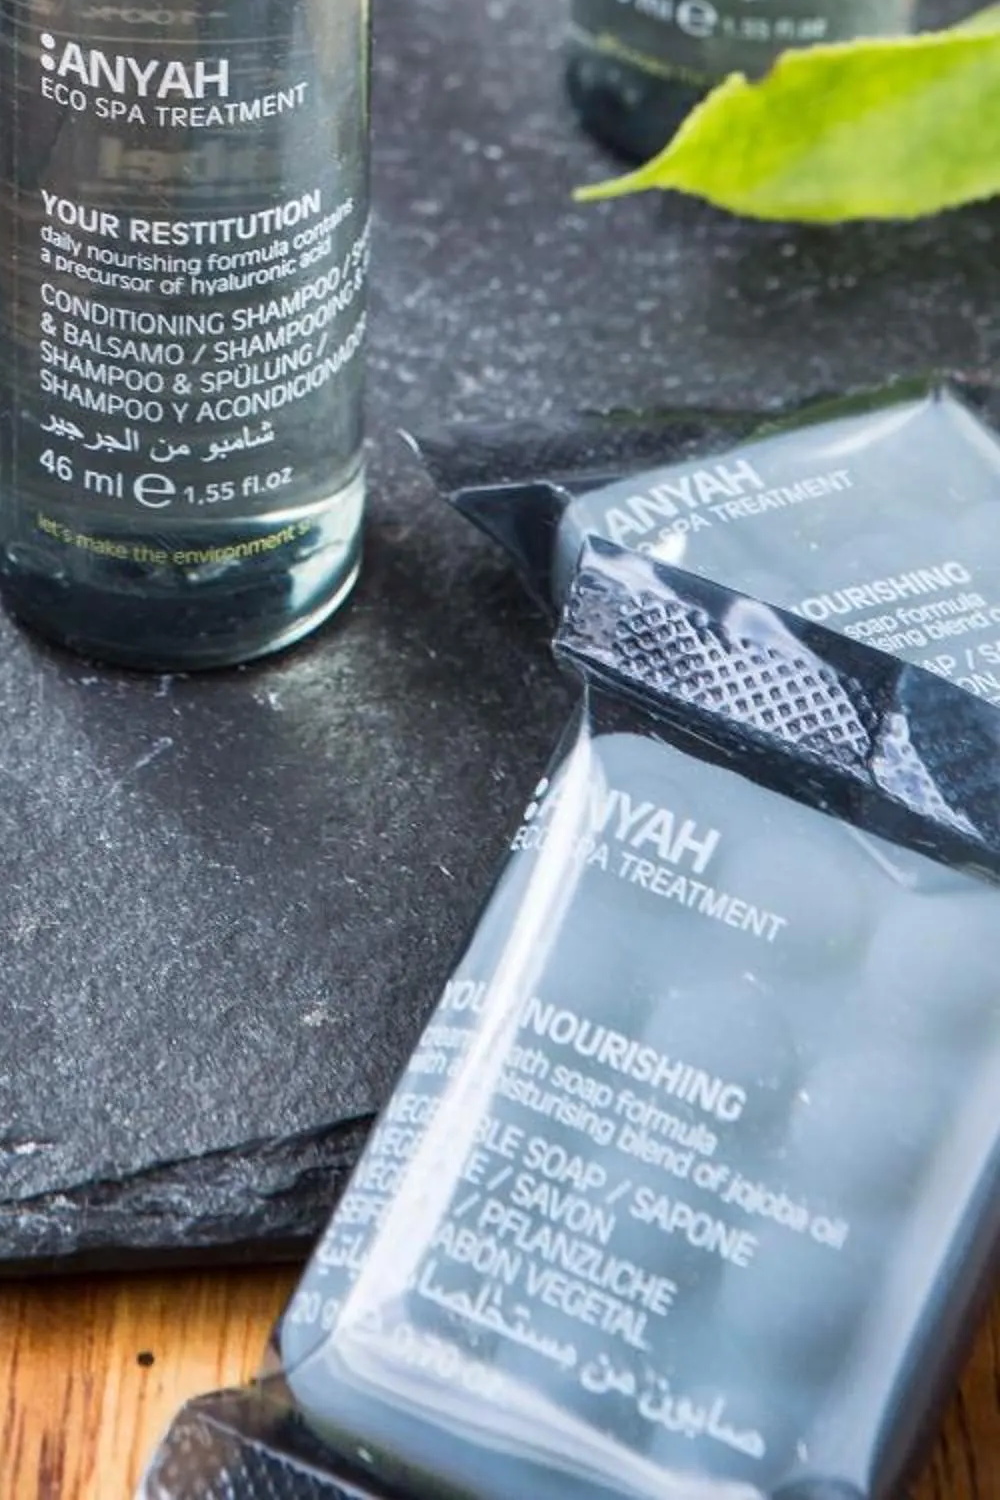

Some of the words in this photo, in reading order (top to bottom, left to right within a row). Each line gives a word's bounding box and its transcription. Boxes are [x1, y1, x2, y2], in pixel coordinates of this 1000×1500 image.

[41, 76, 86, 112] ECO
[95, 97, 146, 125] SPA
[156, 82, 309, 127] TREATMENT
[41, 189, 119, 240] YOUR
[130, 189, 322, 246] RESTITUTION
[40, 225, 84, 256] daily
[87, 247, 202, 277] nourishing
[207, 238, 290, 273] formula
[40, 248, 52, 265] a
[55, 254, 152, 294] precursor
[159, 275, 185, 294] of
[191, 257, 298, 298] hyaluronic
[40, 282, 226, 337] CONDITIONING
[231, 267, 341, 330] SHAMPOO
[40, 311, 58, 338] &
[63, 323, 185, 367] BALSAMO
[213, 279, 354, 363] SHAMPOOING
[39, 368, 165, 423] SHAMPOO
[171, 402, 190, 425] Y
[40, 340, 165, 396] SHAMPOO
[172, 373, 193, 397] &
[199, 343, 314, 395] SPÜLUNG
[39, 449, 74, 482] 46
[84, 469, 124, 499] ml
[184, 481, 236, 506] 1.55
[150, 438, 192, 462] من
[709, 469, 857, 525] TREATMENT
[76, 535, 129, 560] make
[133, 548, 171, 566] the
[173, 525, 295, 566] environment
[790, 561, 972, 621] OURISHING
[843, 614, 899, 641] soap
[896, 592, 988, 627] formula
[923, 610, 994, 640] blend
[619, 853, 789, 943] TREATMENT
[522, 997, 747, 1121] NOURISHING
[553, 1064, 615, 1110] soap
[614, 1089, 718, 1157] formula
[616, 1119, 696, 1180] blend
[693, 1160, 732, 1191] of
[510, 1172, 616, 1245] SAVON
[522, 1137, 607, 1193] SOAP
[629, 1187, 760, 1268] SAPONE
[526, 1260, 653, 1353] VEGETAL
